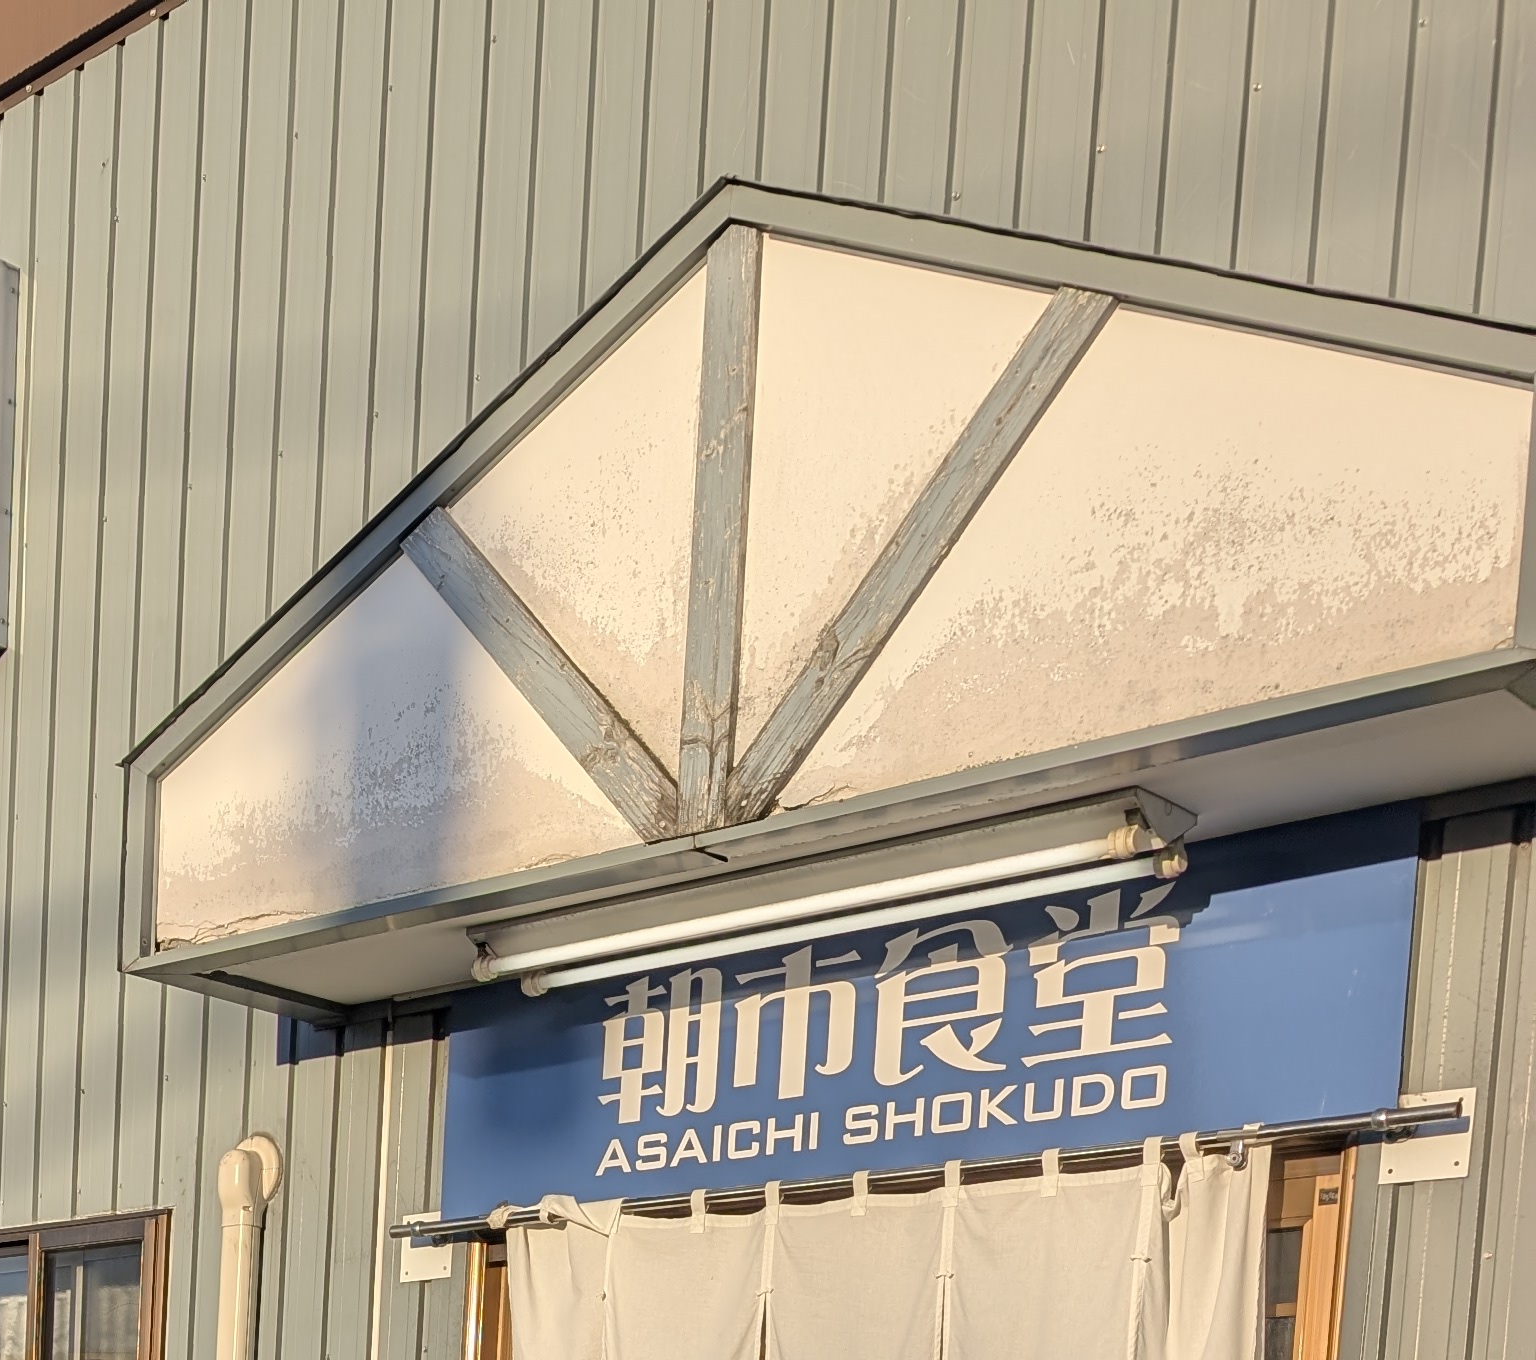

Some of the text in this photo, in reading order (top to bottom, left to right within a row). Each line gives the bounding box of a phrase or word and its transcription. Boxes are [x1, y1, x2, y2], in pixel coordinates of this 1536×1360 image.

[599, 884, 1181, 1124] 朝市食堂
[595, 1063, 1167, 1177] ASAICHI SHOKUDO
